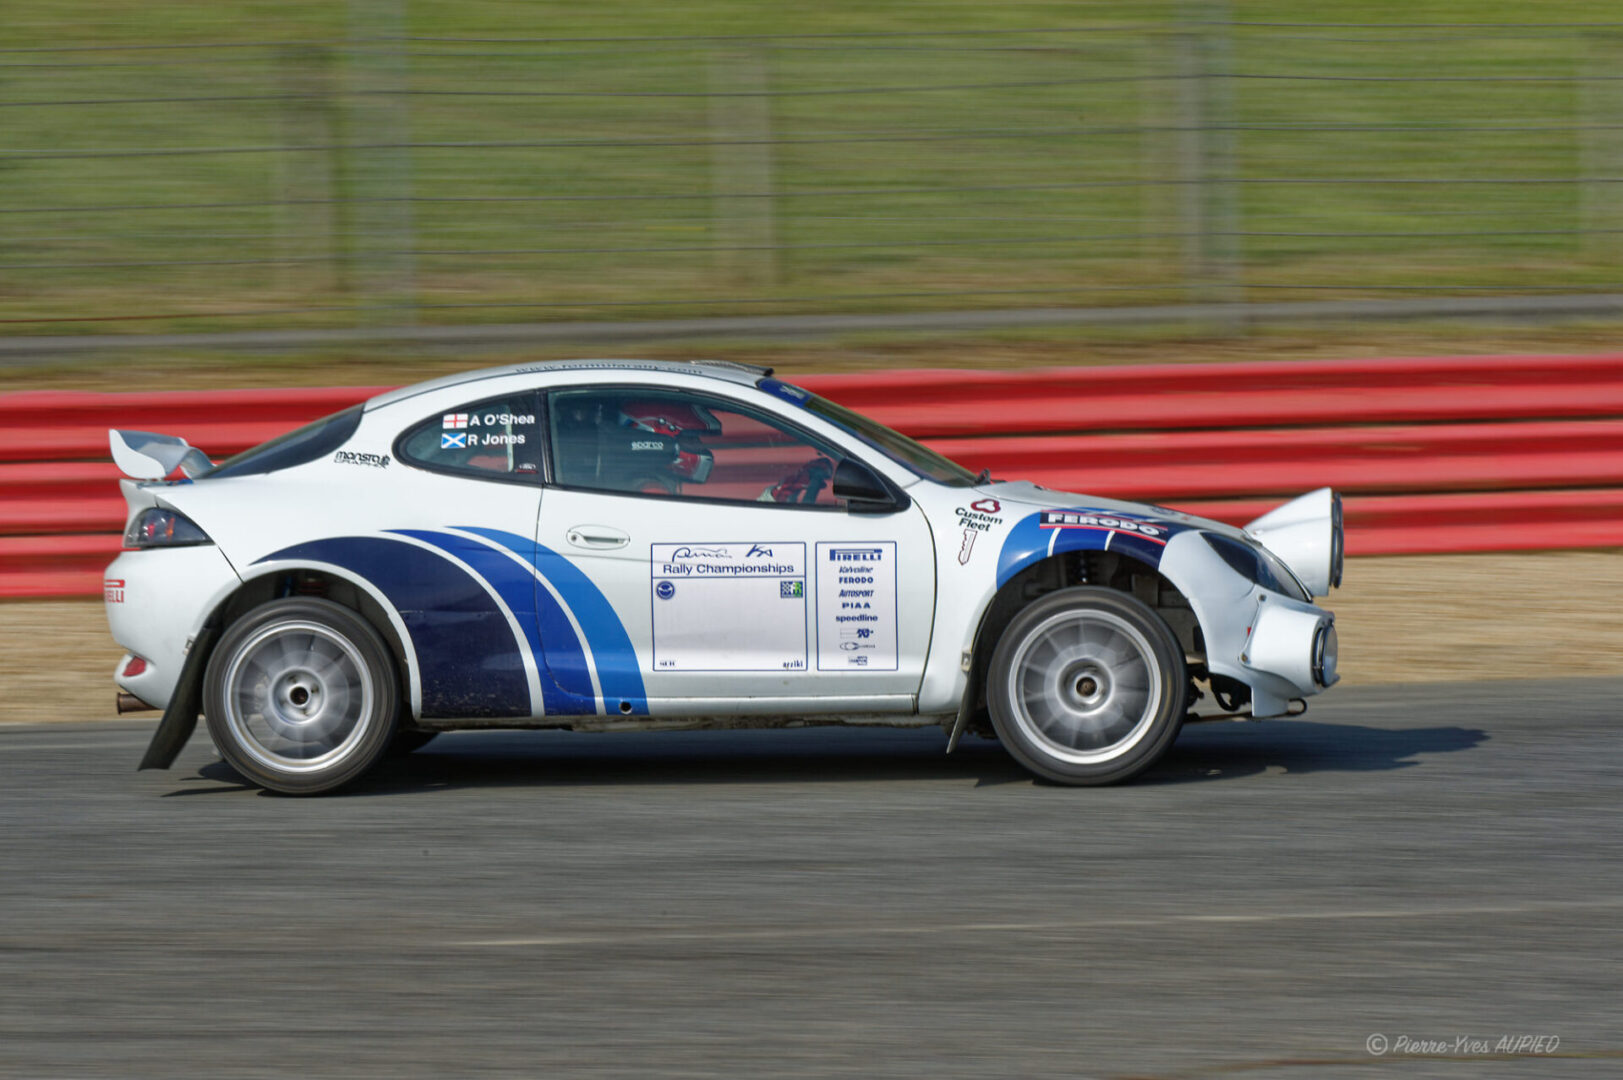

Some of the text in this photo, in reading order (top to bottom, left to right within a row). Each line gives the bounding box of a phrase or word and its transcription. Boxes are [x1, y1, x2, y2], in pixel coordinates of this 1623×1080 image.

[469, 414, 536, 427] A O'Shea
[468, 433, 526, 446] R Jones
[955, 507, 1004, 525] Custom
[958, 517, 991, 532] Fleet
[1047, 511, 1160, 537] FERODO
[829, 548, 883, 561] PIRELLI
[663, 563, 795, 576] Rally Championships
[838, 576, 874, 584] FERODO
[835, 613, 879, 623] speedline
